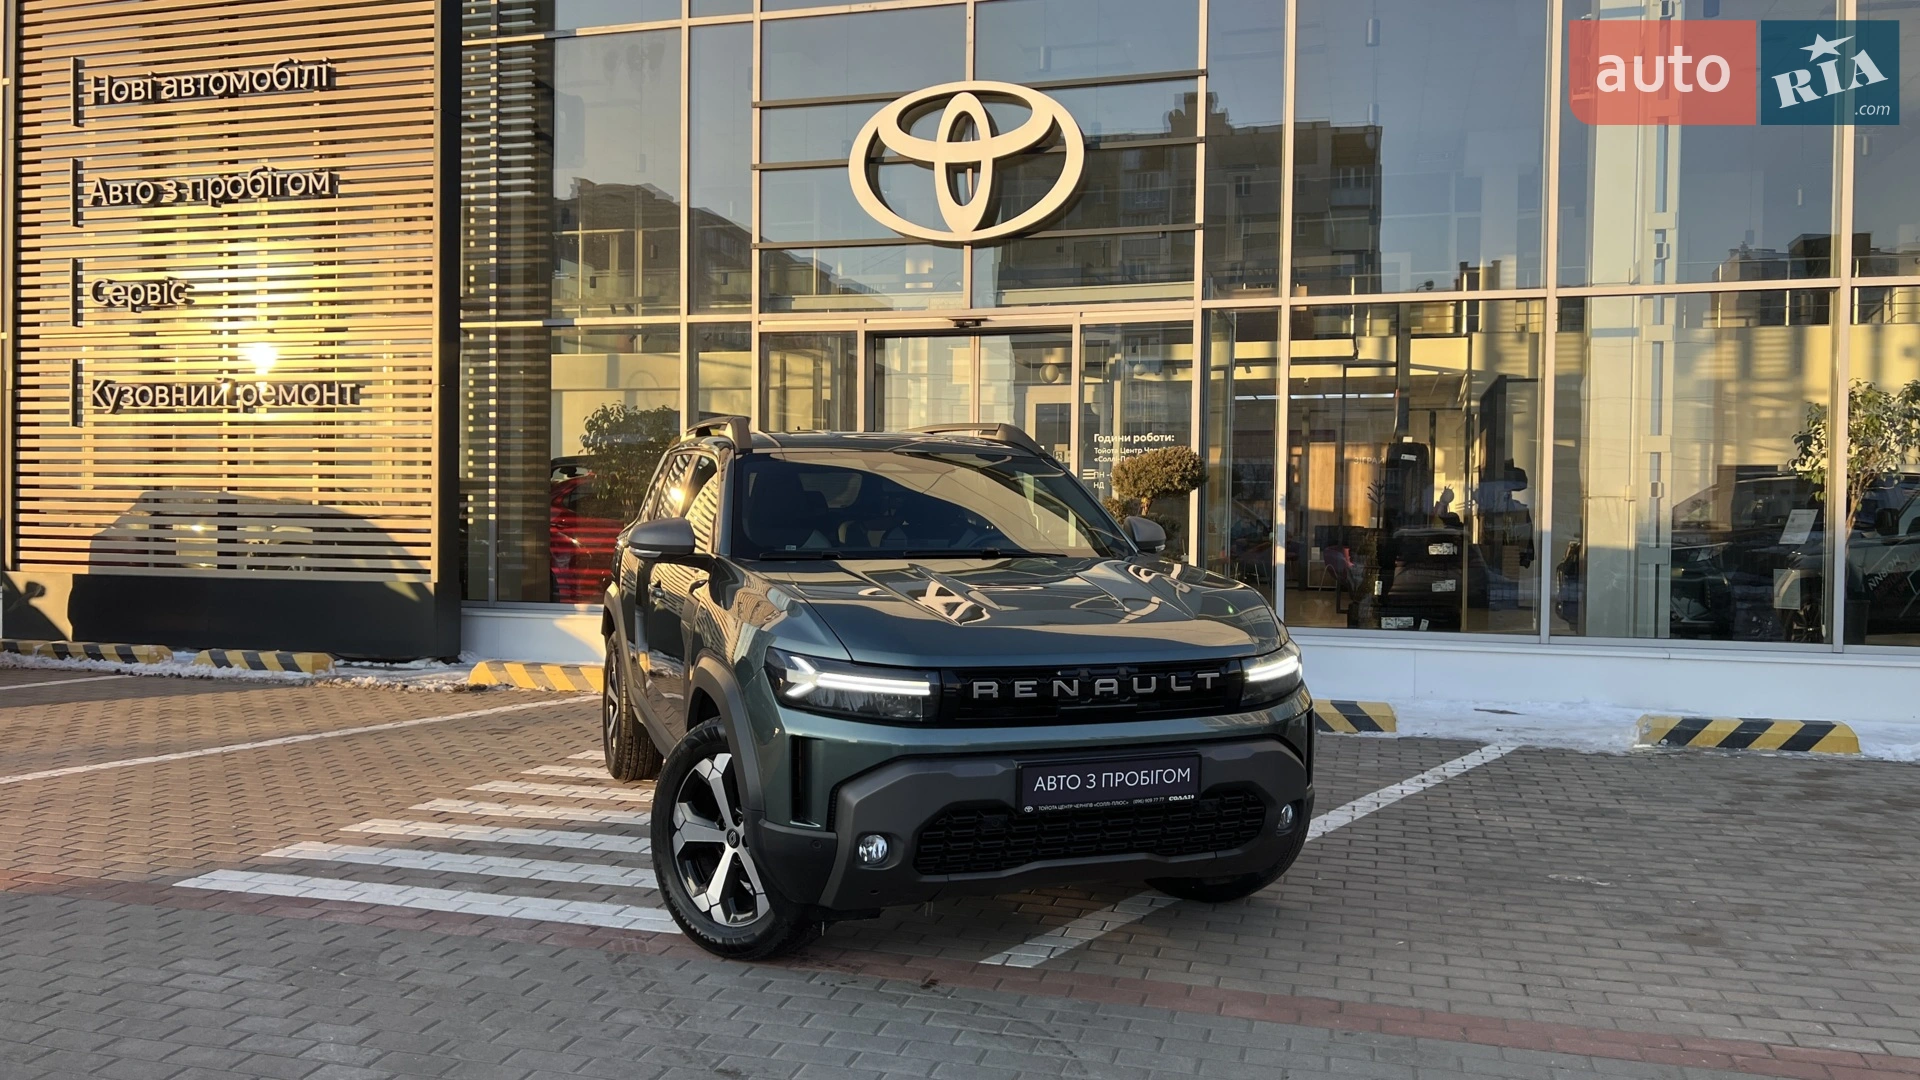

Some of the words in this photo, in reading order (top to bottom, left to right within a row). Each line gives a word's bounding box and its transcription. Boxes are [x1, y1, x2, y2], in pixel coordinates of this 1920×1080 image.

[90, 70, 155, 104] Нові
[161, 57, 331, 100] автомобілі
[90, 177, 155, 206] Авто
[161, 179, 179, 203] з
[188, 166, 331, 208] пробігом
[89, 276, 187, 313] Сервіс
[90, 377, 229, 414] Кузовний
[239, 382, 357, 413] ремонт
[1093, 433, 1131, 443] Години
[1133, 432, 1175, 444] роботи:
[1120, 447, 1143, 456] Центр
[972, 672, 1220, 699] RENAULT
[1033, 774, 1081, 792] АВТО
[1085, 773, 1097, 789] З
[1101, 767, 1191, 788] ПРОБІГОМ
